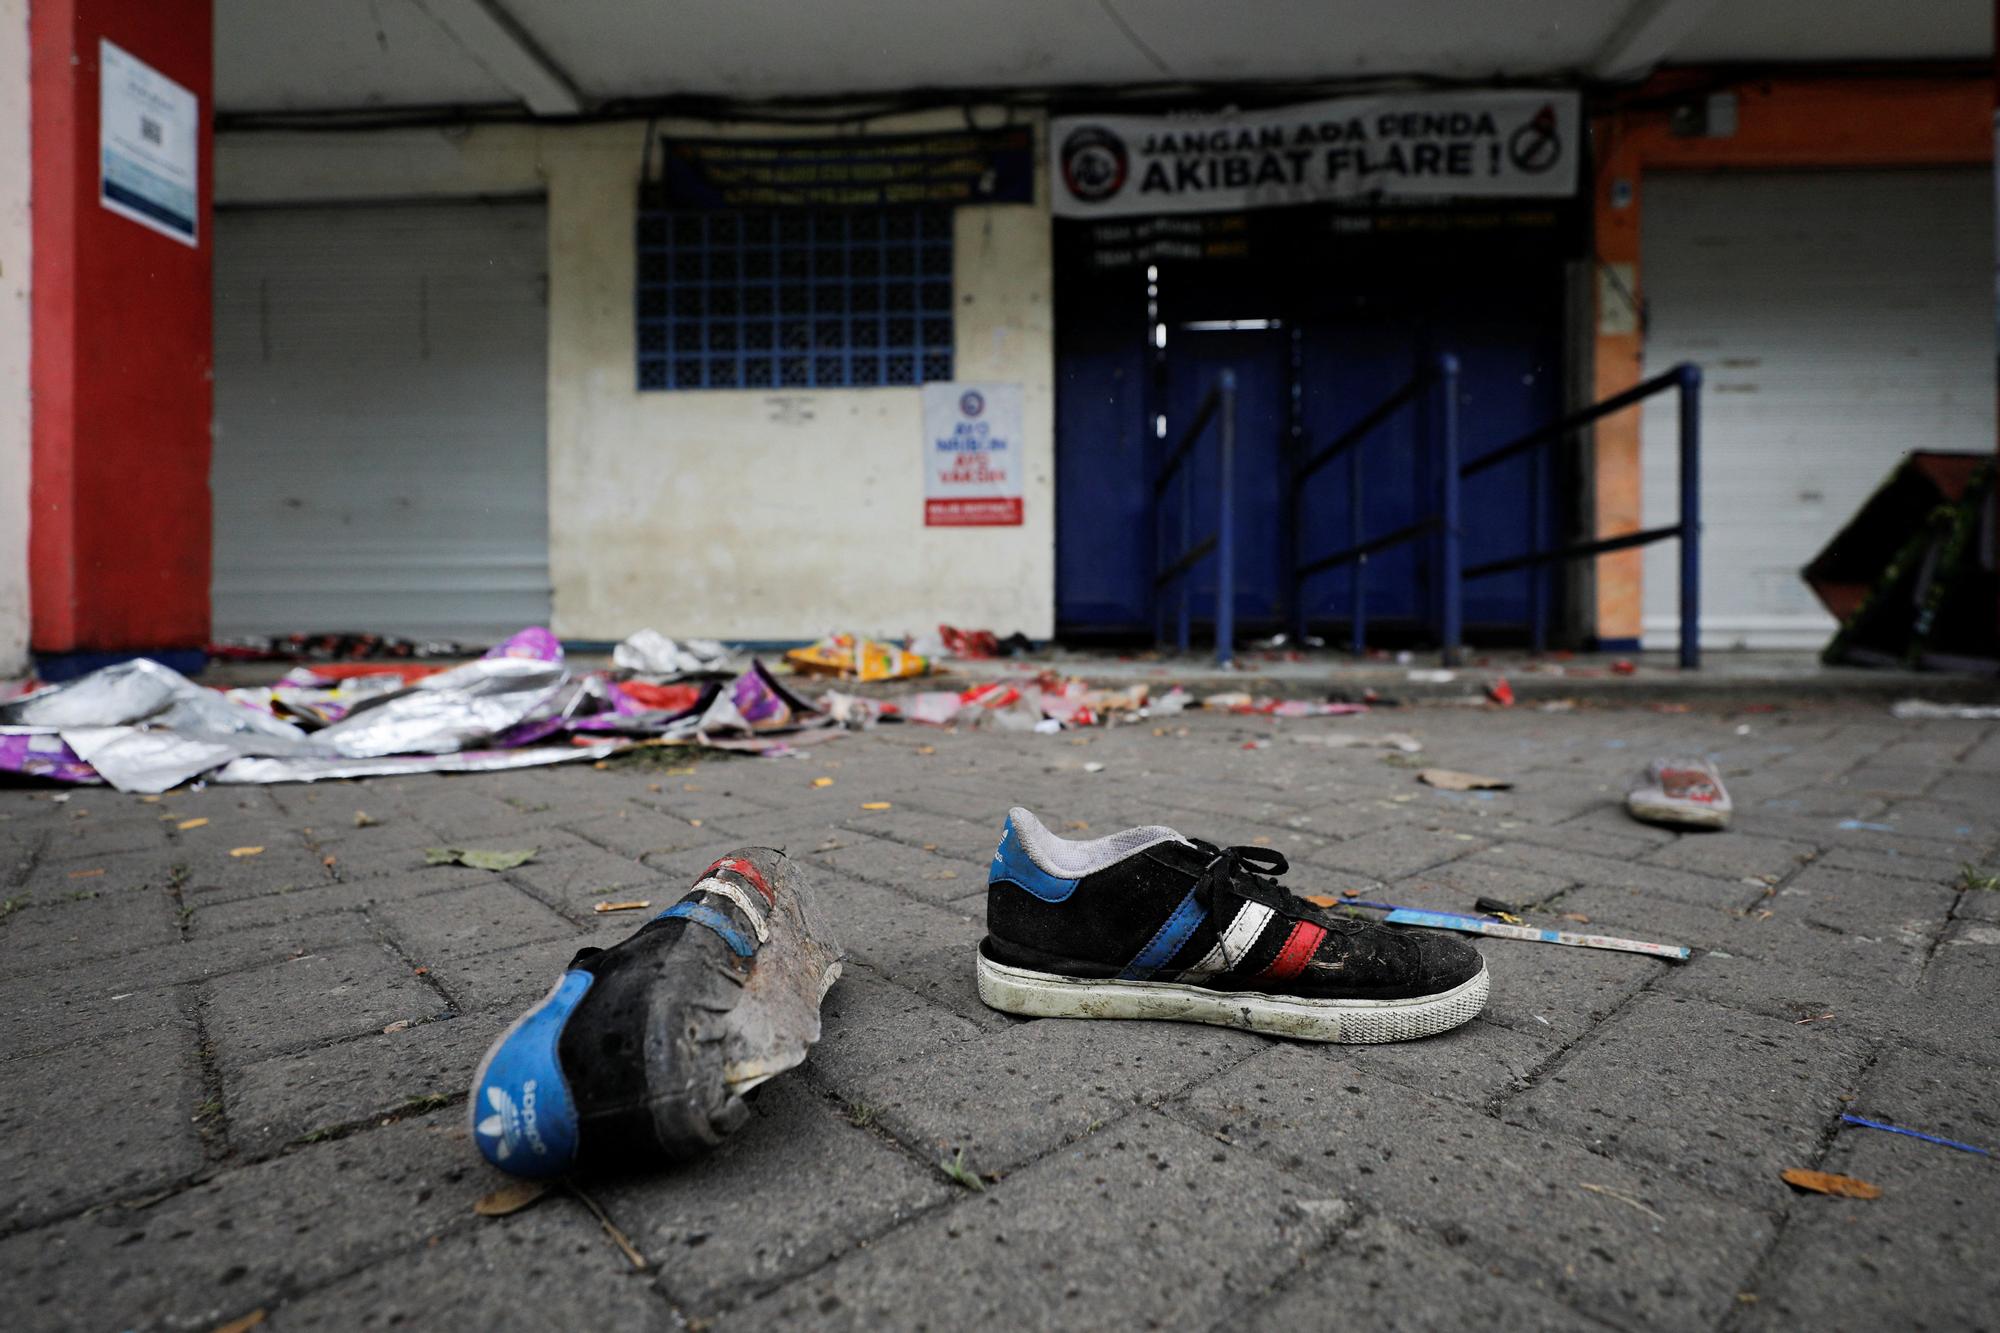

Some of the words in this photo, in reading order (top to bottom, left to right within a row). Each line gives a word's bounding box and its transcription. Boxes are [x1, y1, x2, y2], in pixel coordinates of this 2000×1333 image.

[1142, 126, 1284, 154] JANGAN
[1141, 153, 1312, 194] AKIBAT
[1327, 141, 1474, 181] FLARE
